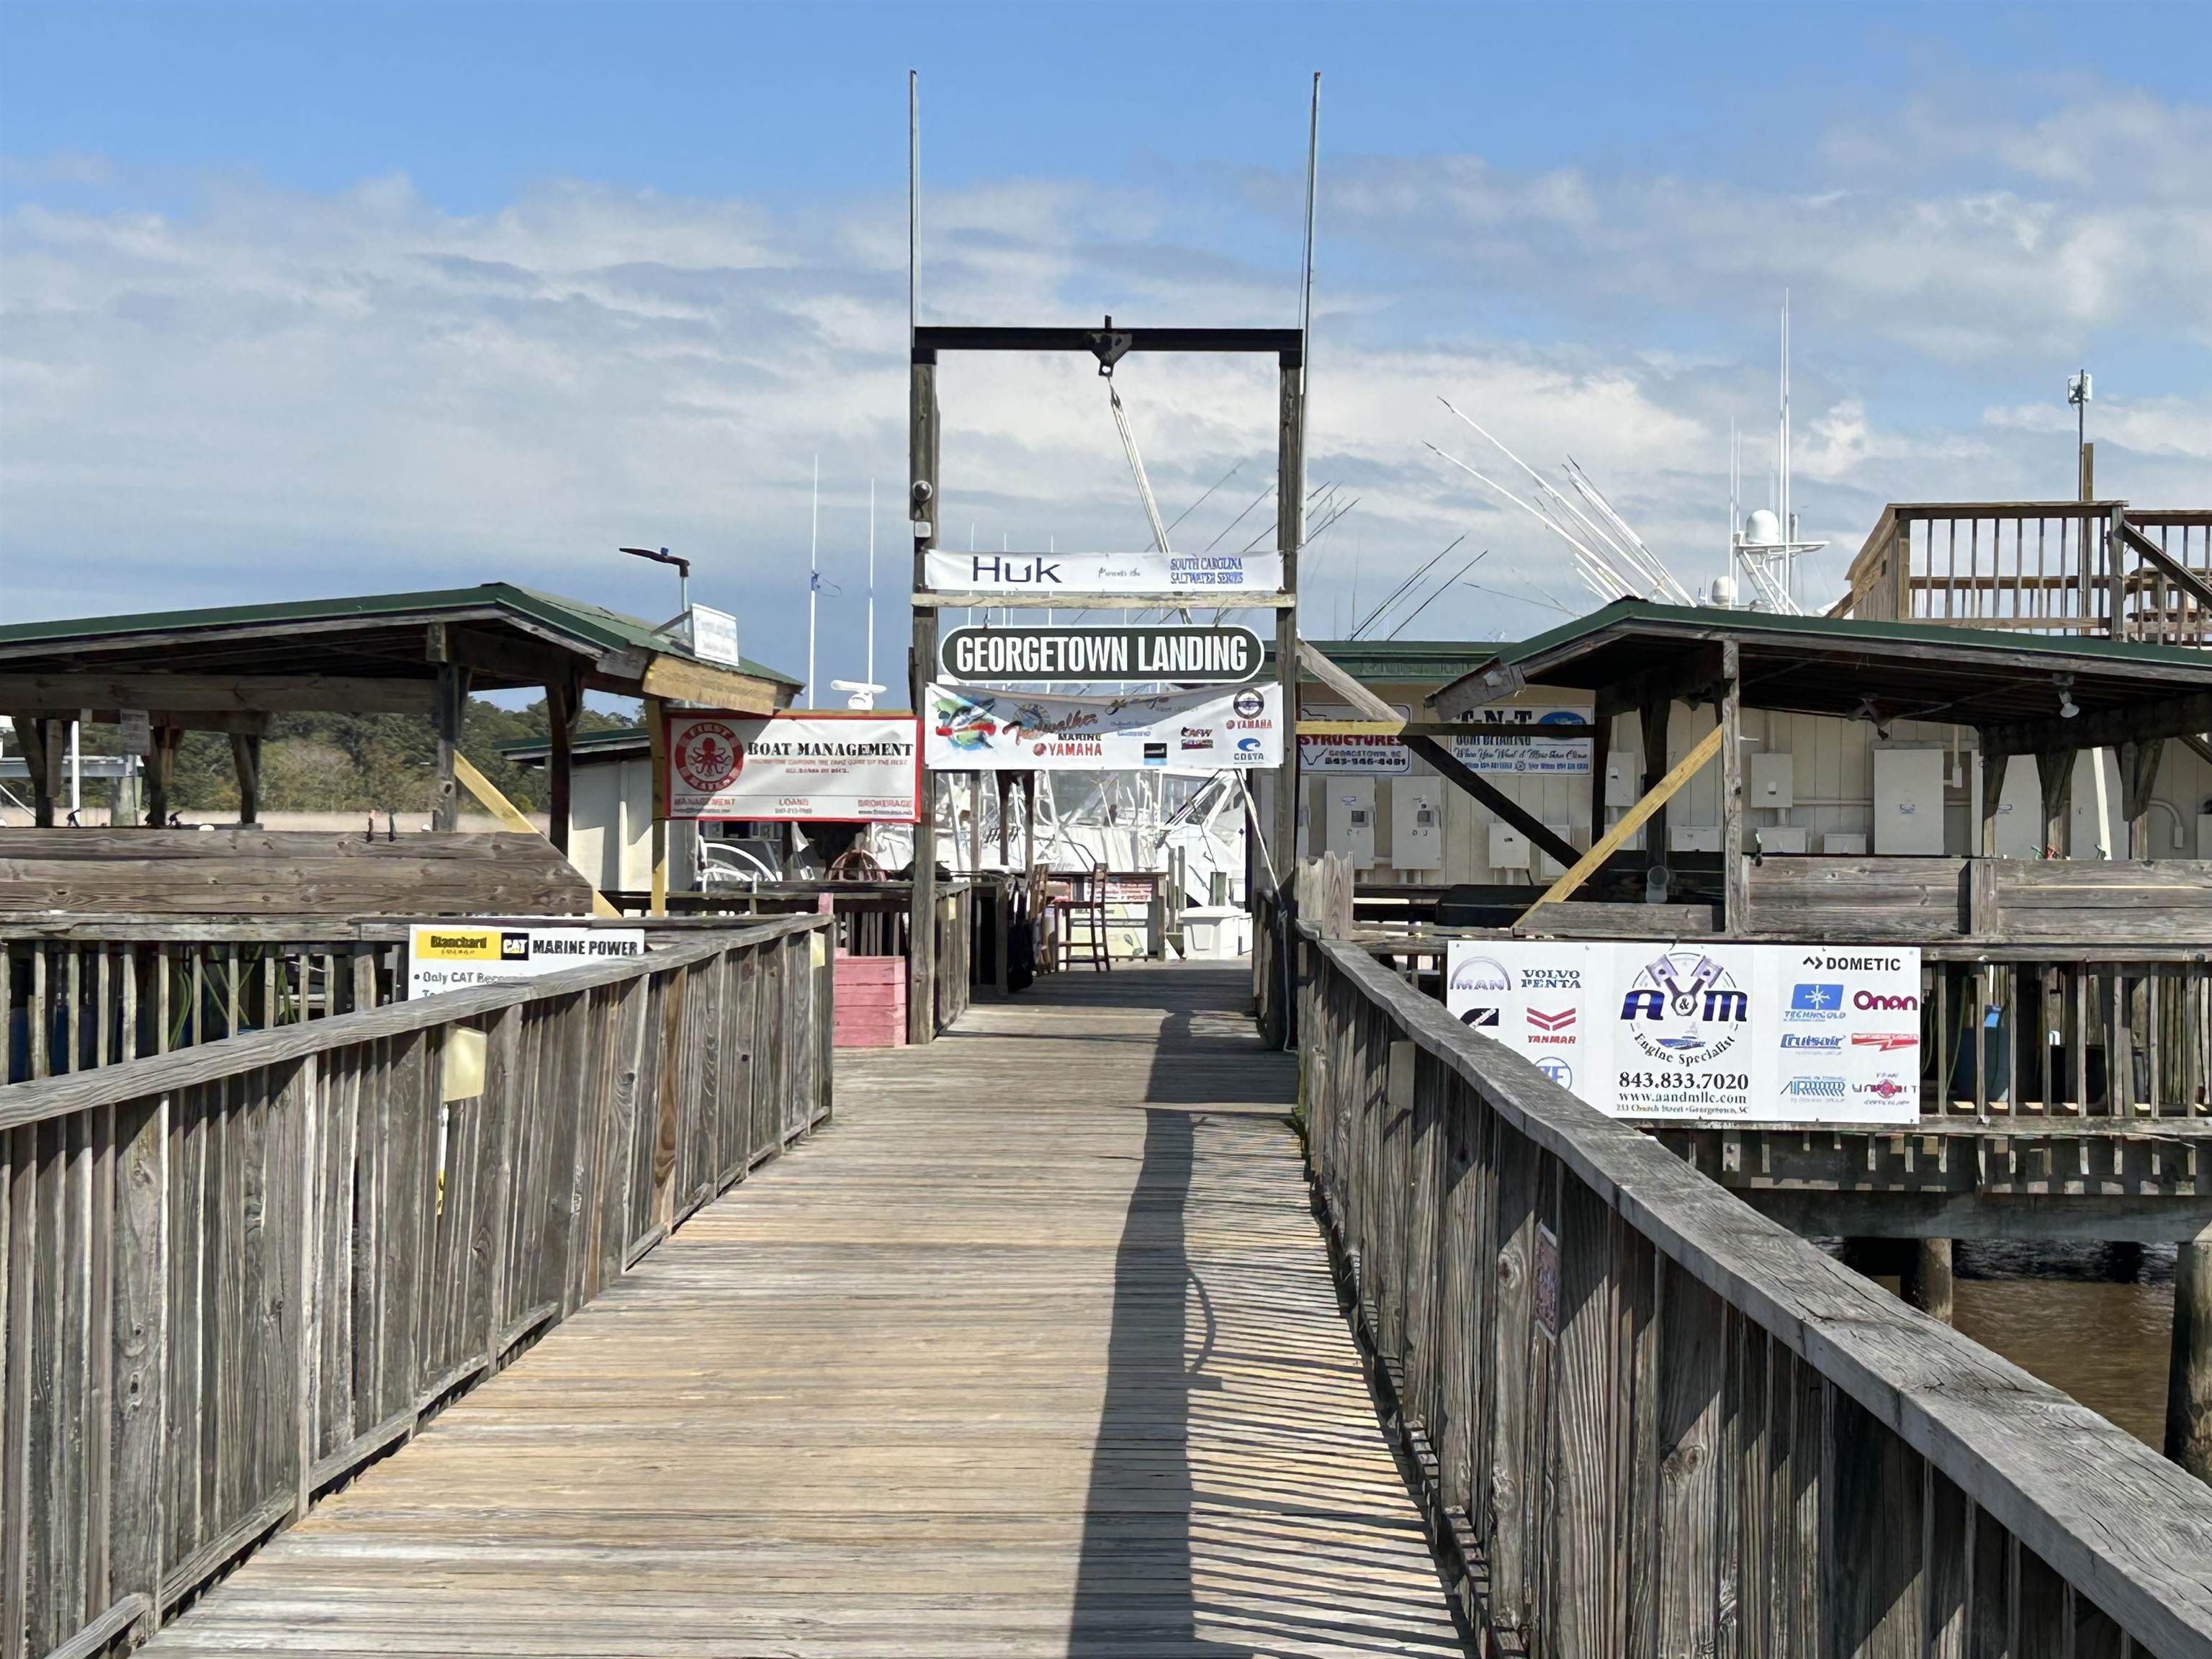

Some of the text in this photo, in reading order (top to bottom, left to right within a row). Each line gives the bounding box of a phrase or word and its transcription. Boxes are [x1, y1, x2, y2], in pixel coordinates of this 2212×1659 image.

[1170, 557, 1243, 570] SOUTH CAROLINA
[1171, 572, 1216, 584] SALTWATER
[956, 635, 1247, 673] GEORGETOWN LANDING
[1237, 719, 1273, 729] YAMAHA
[1300, 734, 1405, 746] STRUCTURES
[747, 742, 914, 756] BOAT MANAGEMENT
[1048, 743, 1102, 756] YAMAHA
[431, 935, 487, 948] Blanchard
[503, 939, 638, 956] CAT MARINE POWER
[1826, 957, 1901, 971] DOMETIC
[423, 971, 448, 984] Only
[451, 971, 475, 983] CAT
[1521, 969, 1581, 979] VOLVO
[1456, 979, 1504, 990] MAN
[1521, 979, 1581, 989] PENTA
[1528, 1034, 1576, 1044] YANMAR
[1635, 1033, 1735, 1067] Engine Specialist
[1619, 1071, 1750, 1090] 843.833.7020
[1619, 1091, 1748, 1104] www.aandmllc.com
